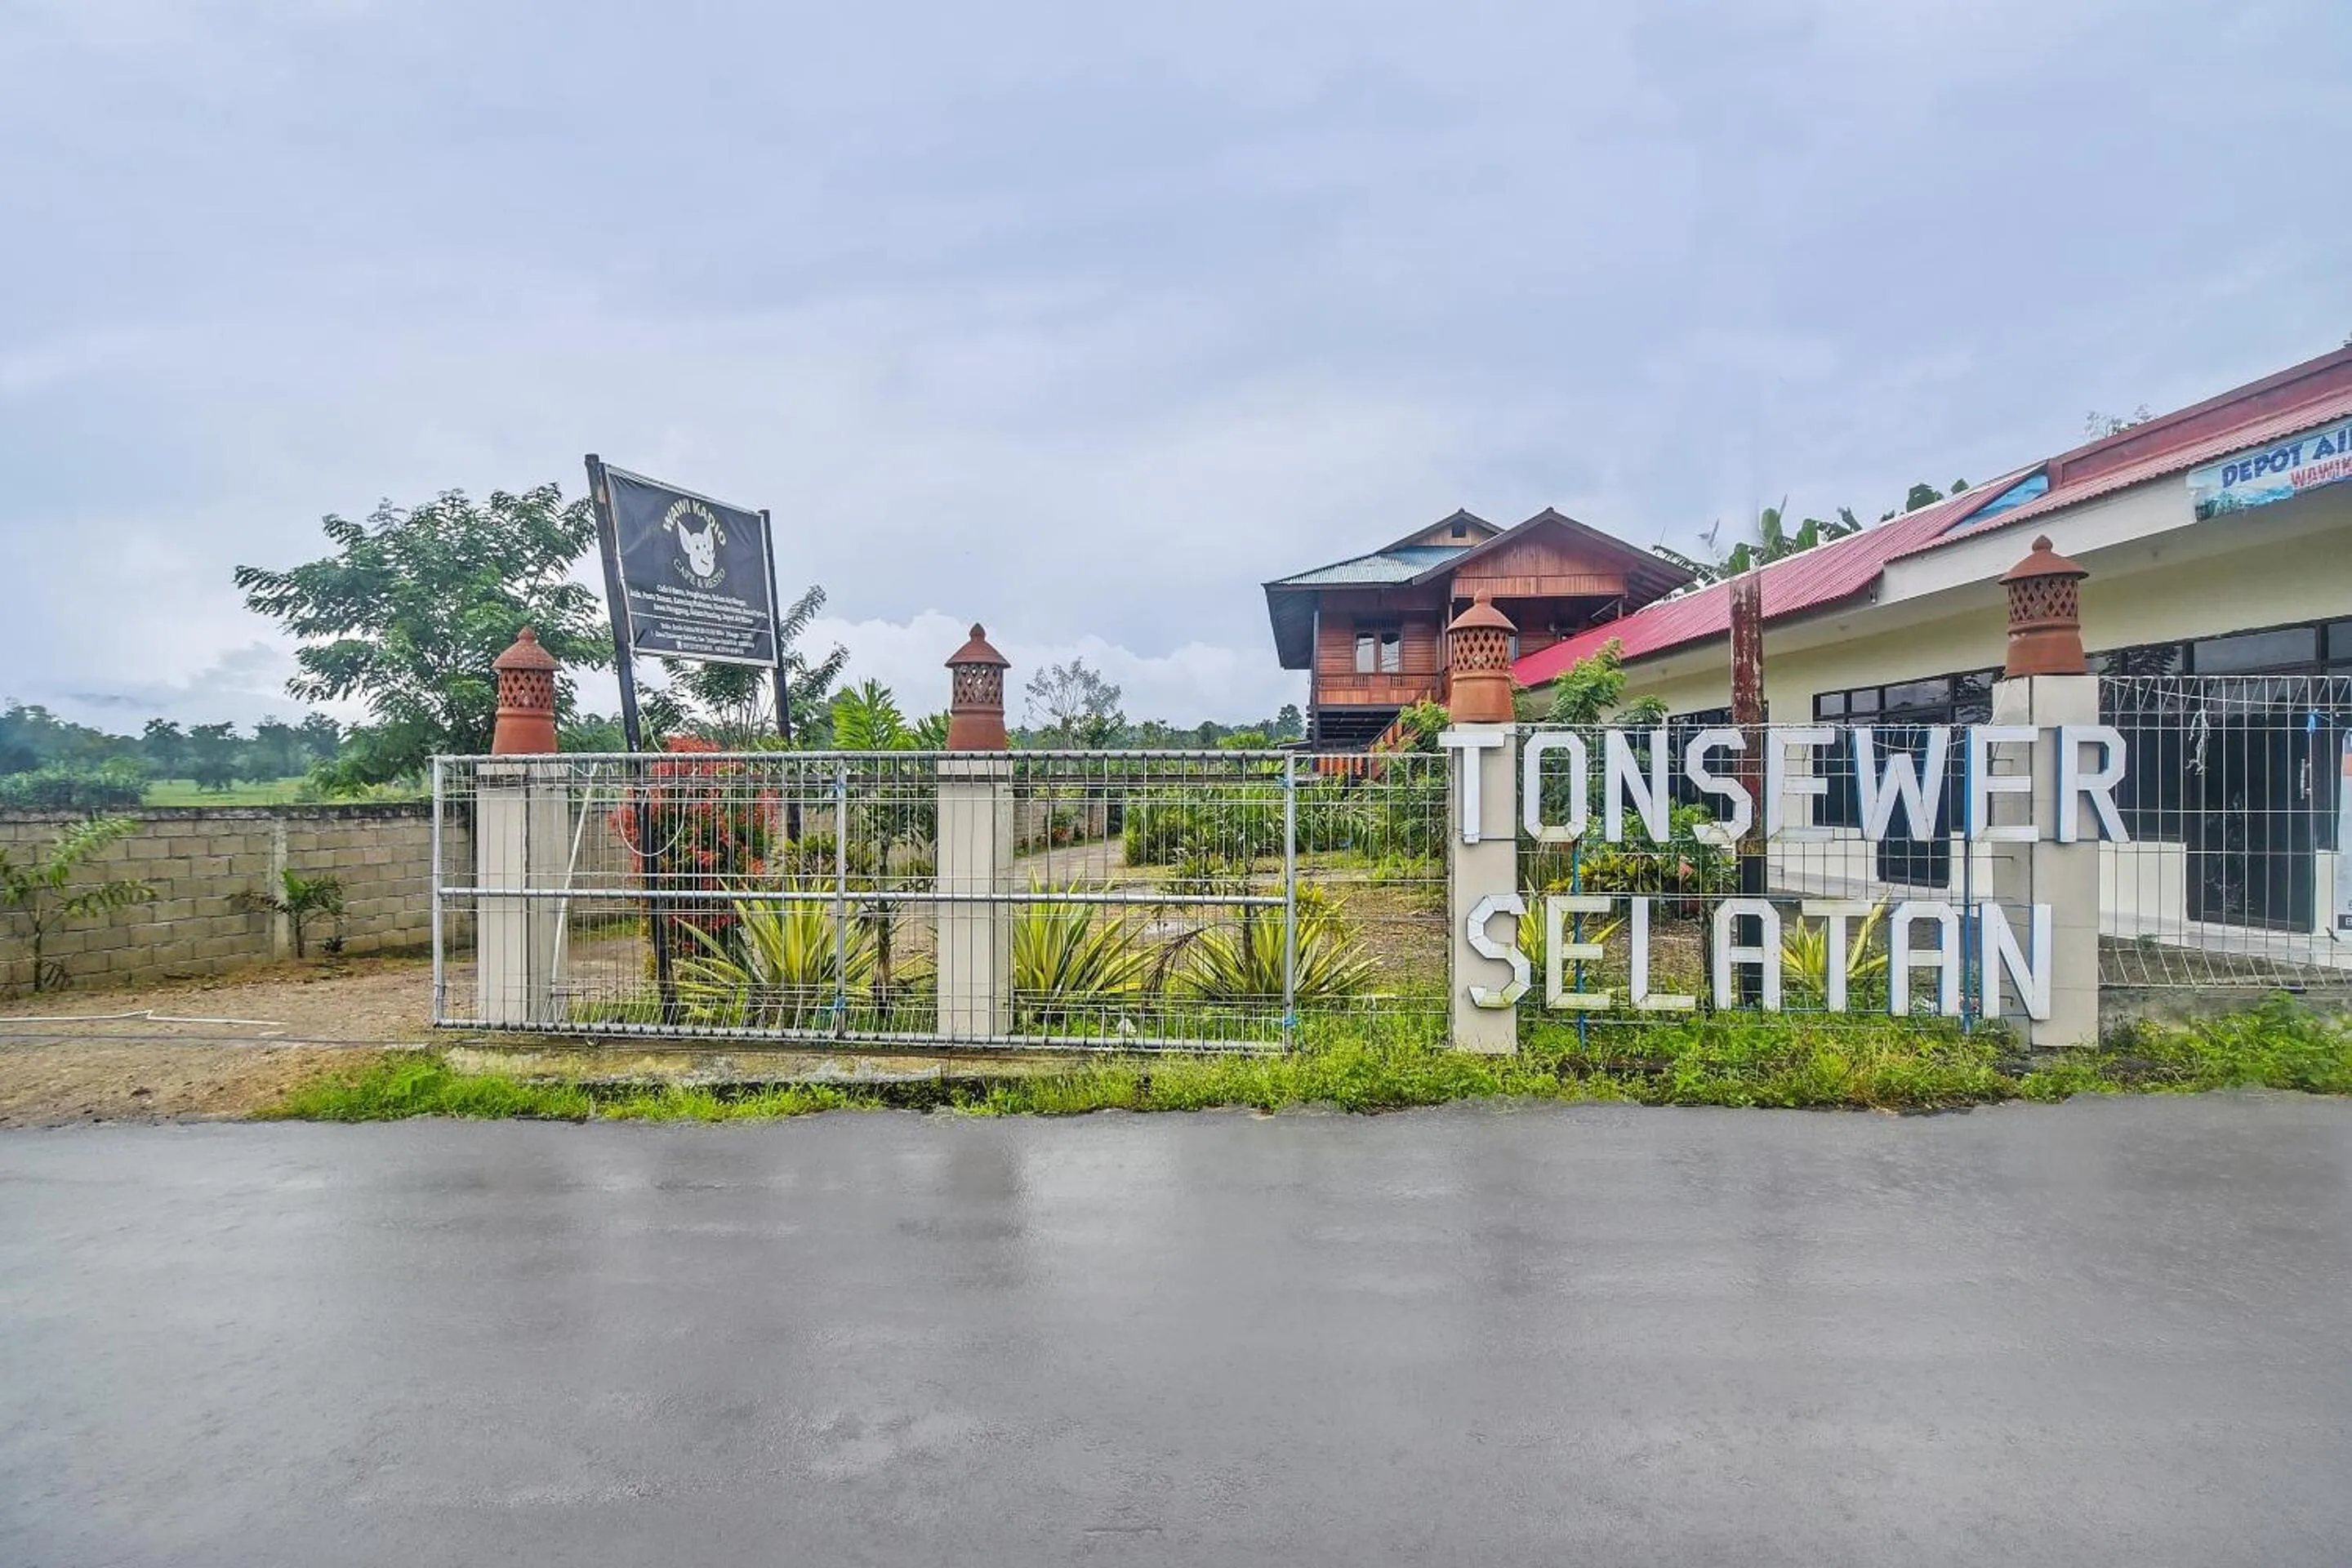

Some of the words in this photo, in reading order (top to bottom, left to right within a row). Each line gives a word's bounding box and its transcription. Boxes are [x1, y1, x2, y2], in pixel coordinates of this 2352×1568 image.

[2221, 442, 2304, 488] DEPOT
[663, 498, 691, 532] WAWI
[1438, 724, 2130, 844] TONSEWER
[1467, 893, 2052, 1021] SELATAN
